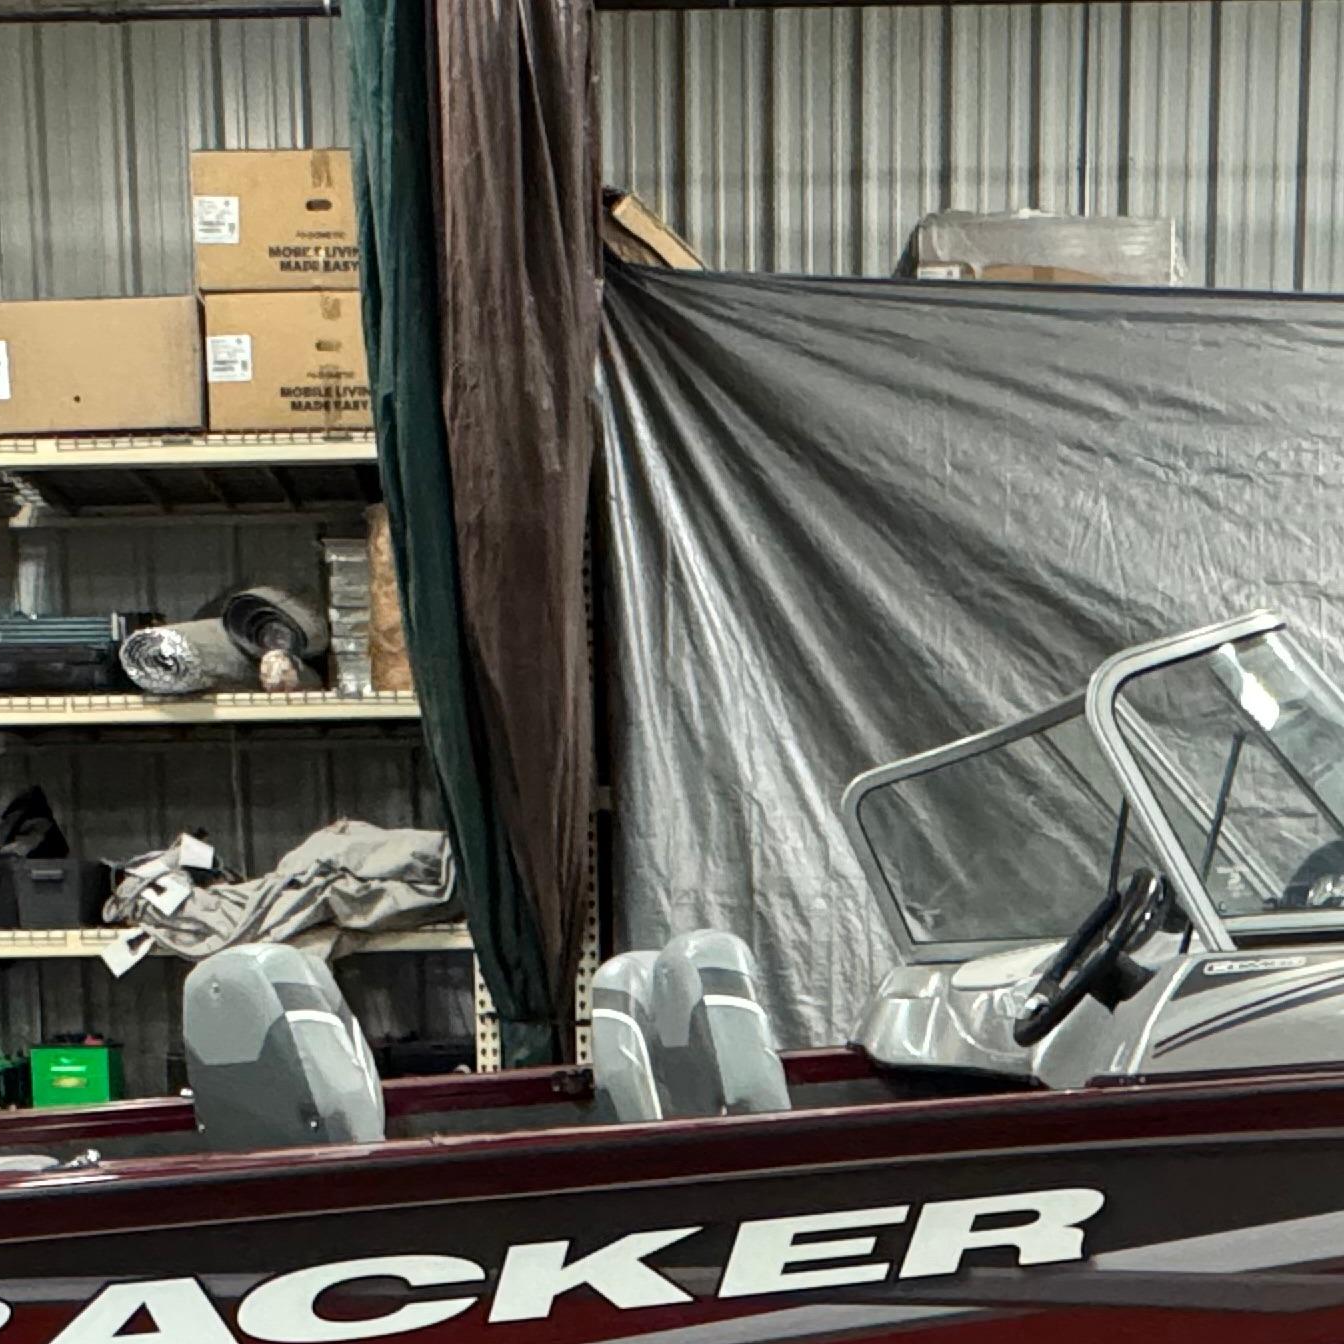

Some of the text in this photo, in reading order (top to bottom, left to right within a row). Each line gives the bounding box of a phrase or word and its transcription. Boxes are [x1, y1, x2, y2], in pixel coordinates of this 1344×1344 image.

[280, 260, 360, 272] MADE EASY
[280, 386, 332, 397] MOBILE
[290, 400, 368, 412] MADE EASY
